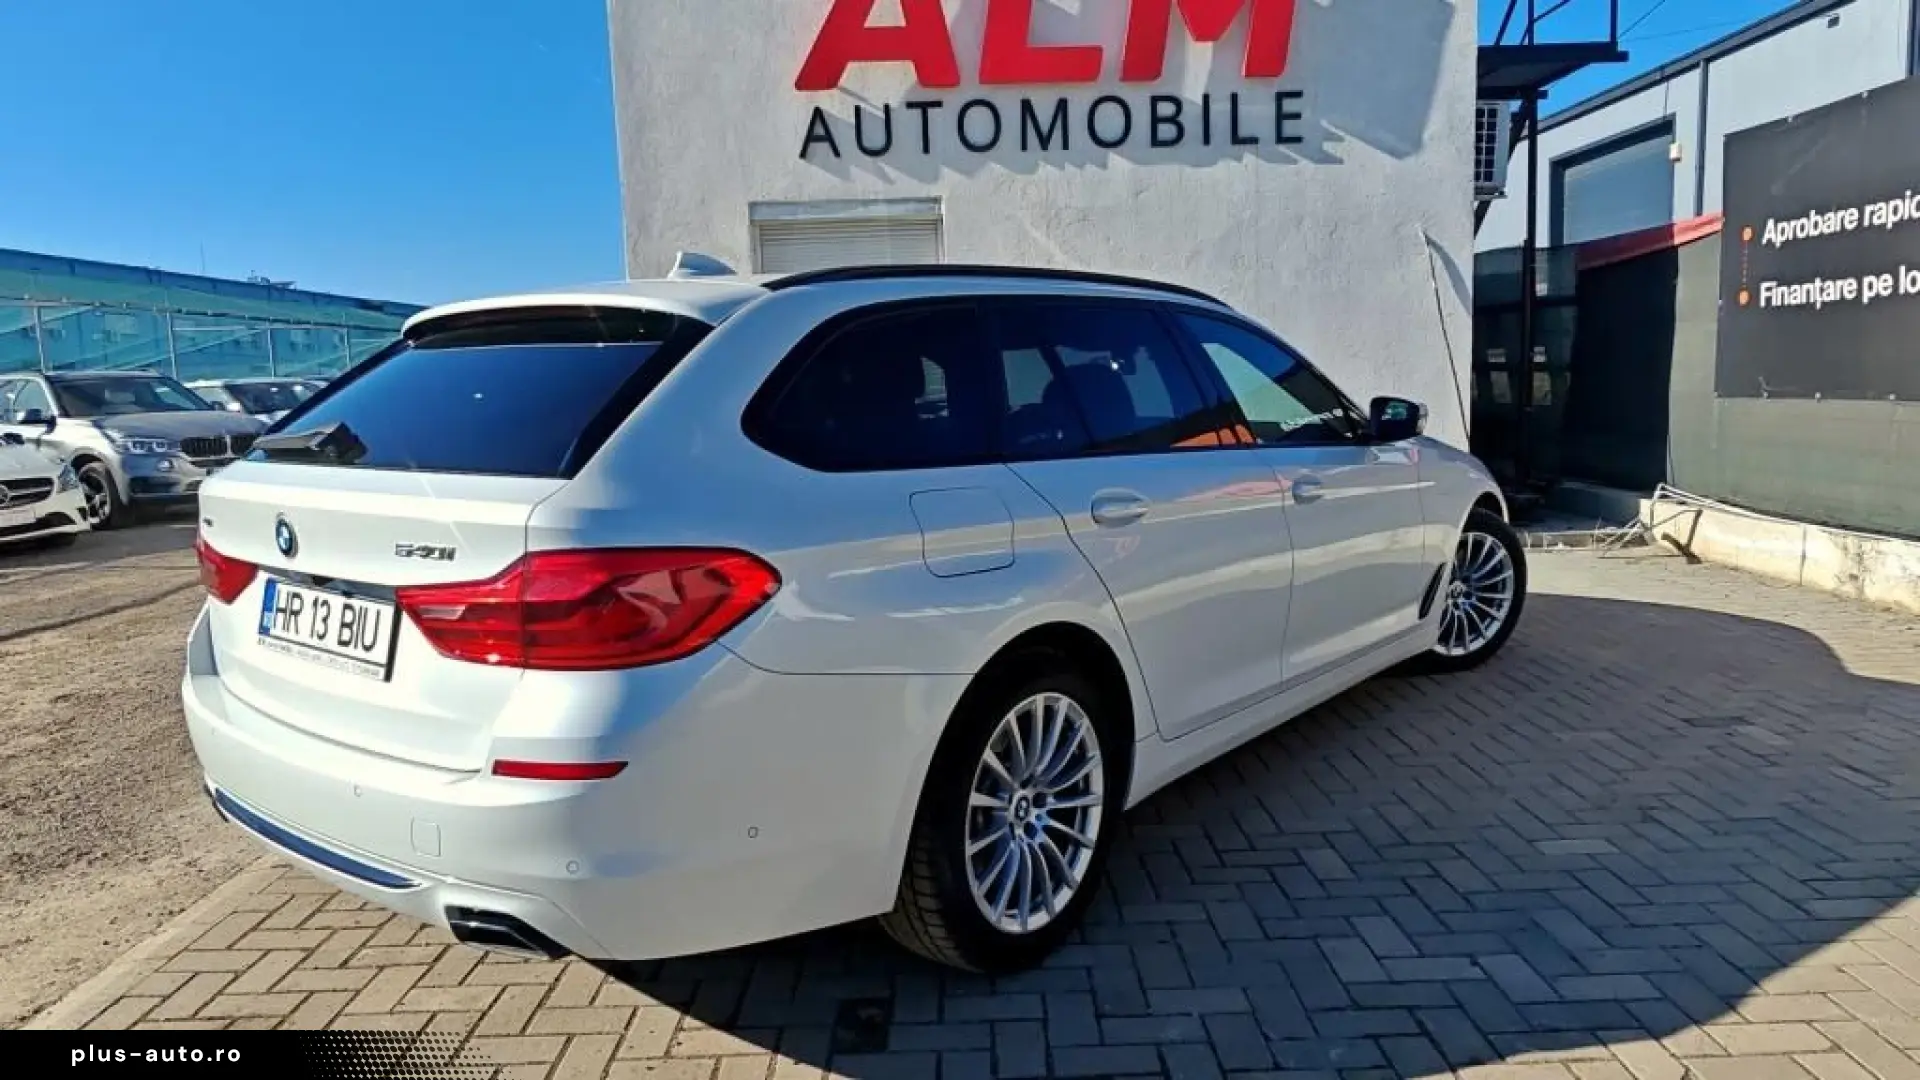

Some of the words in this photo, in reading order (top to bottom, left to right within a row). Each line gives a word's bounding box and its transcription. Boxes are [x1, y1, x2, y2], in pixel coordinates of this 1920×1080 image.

[795, 0, 1296, 92] ALM
[799, 89, 1305, 160] AUTOMOBILE
[1761, 208, 1859, 249] Aprobare
[1758, 275, 1858, 311] Finanțare
[1861, 271, 1894, 305] pe
[273, 587, 305, 636] HR
[309, 595, 332, 642] 13
[336, 602, 382, 653] BIU
